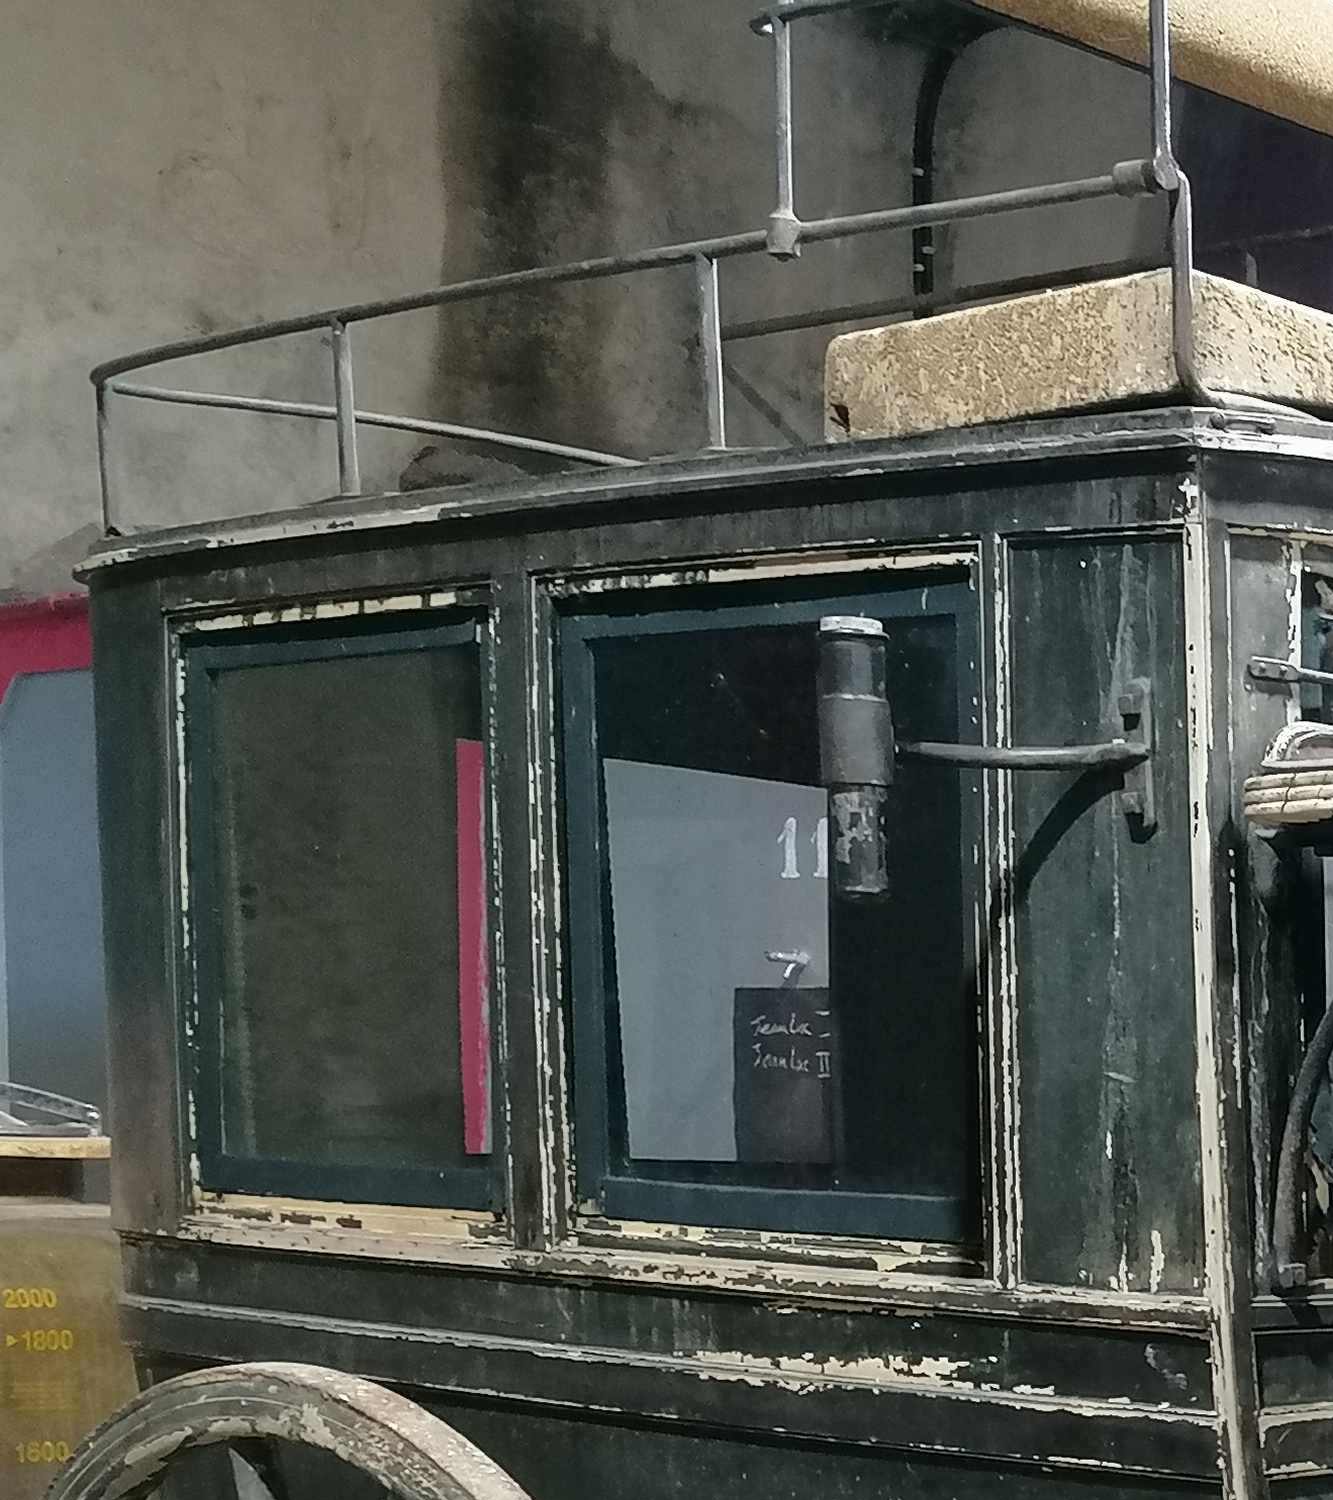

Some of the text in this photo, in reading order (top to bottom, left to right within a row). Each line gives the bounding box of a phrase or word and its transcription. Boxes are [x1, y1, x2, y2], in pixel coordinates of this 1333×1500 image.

[2, 1288, 57, 1308] 2000
[22, 1329, 74, 1351] 1800
[15, 1440, 70, 1463] 1600
